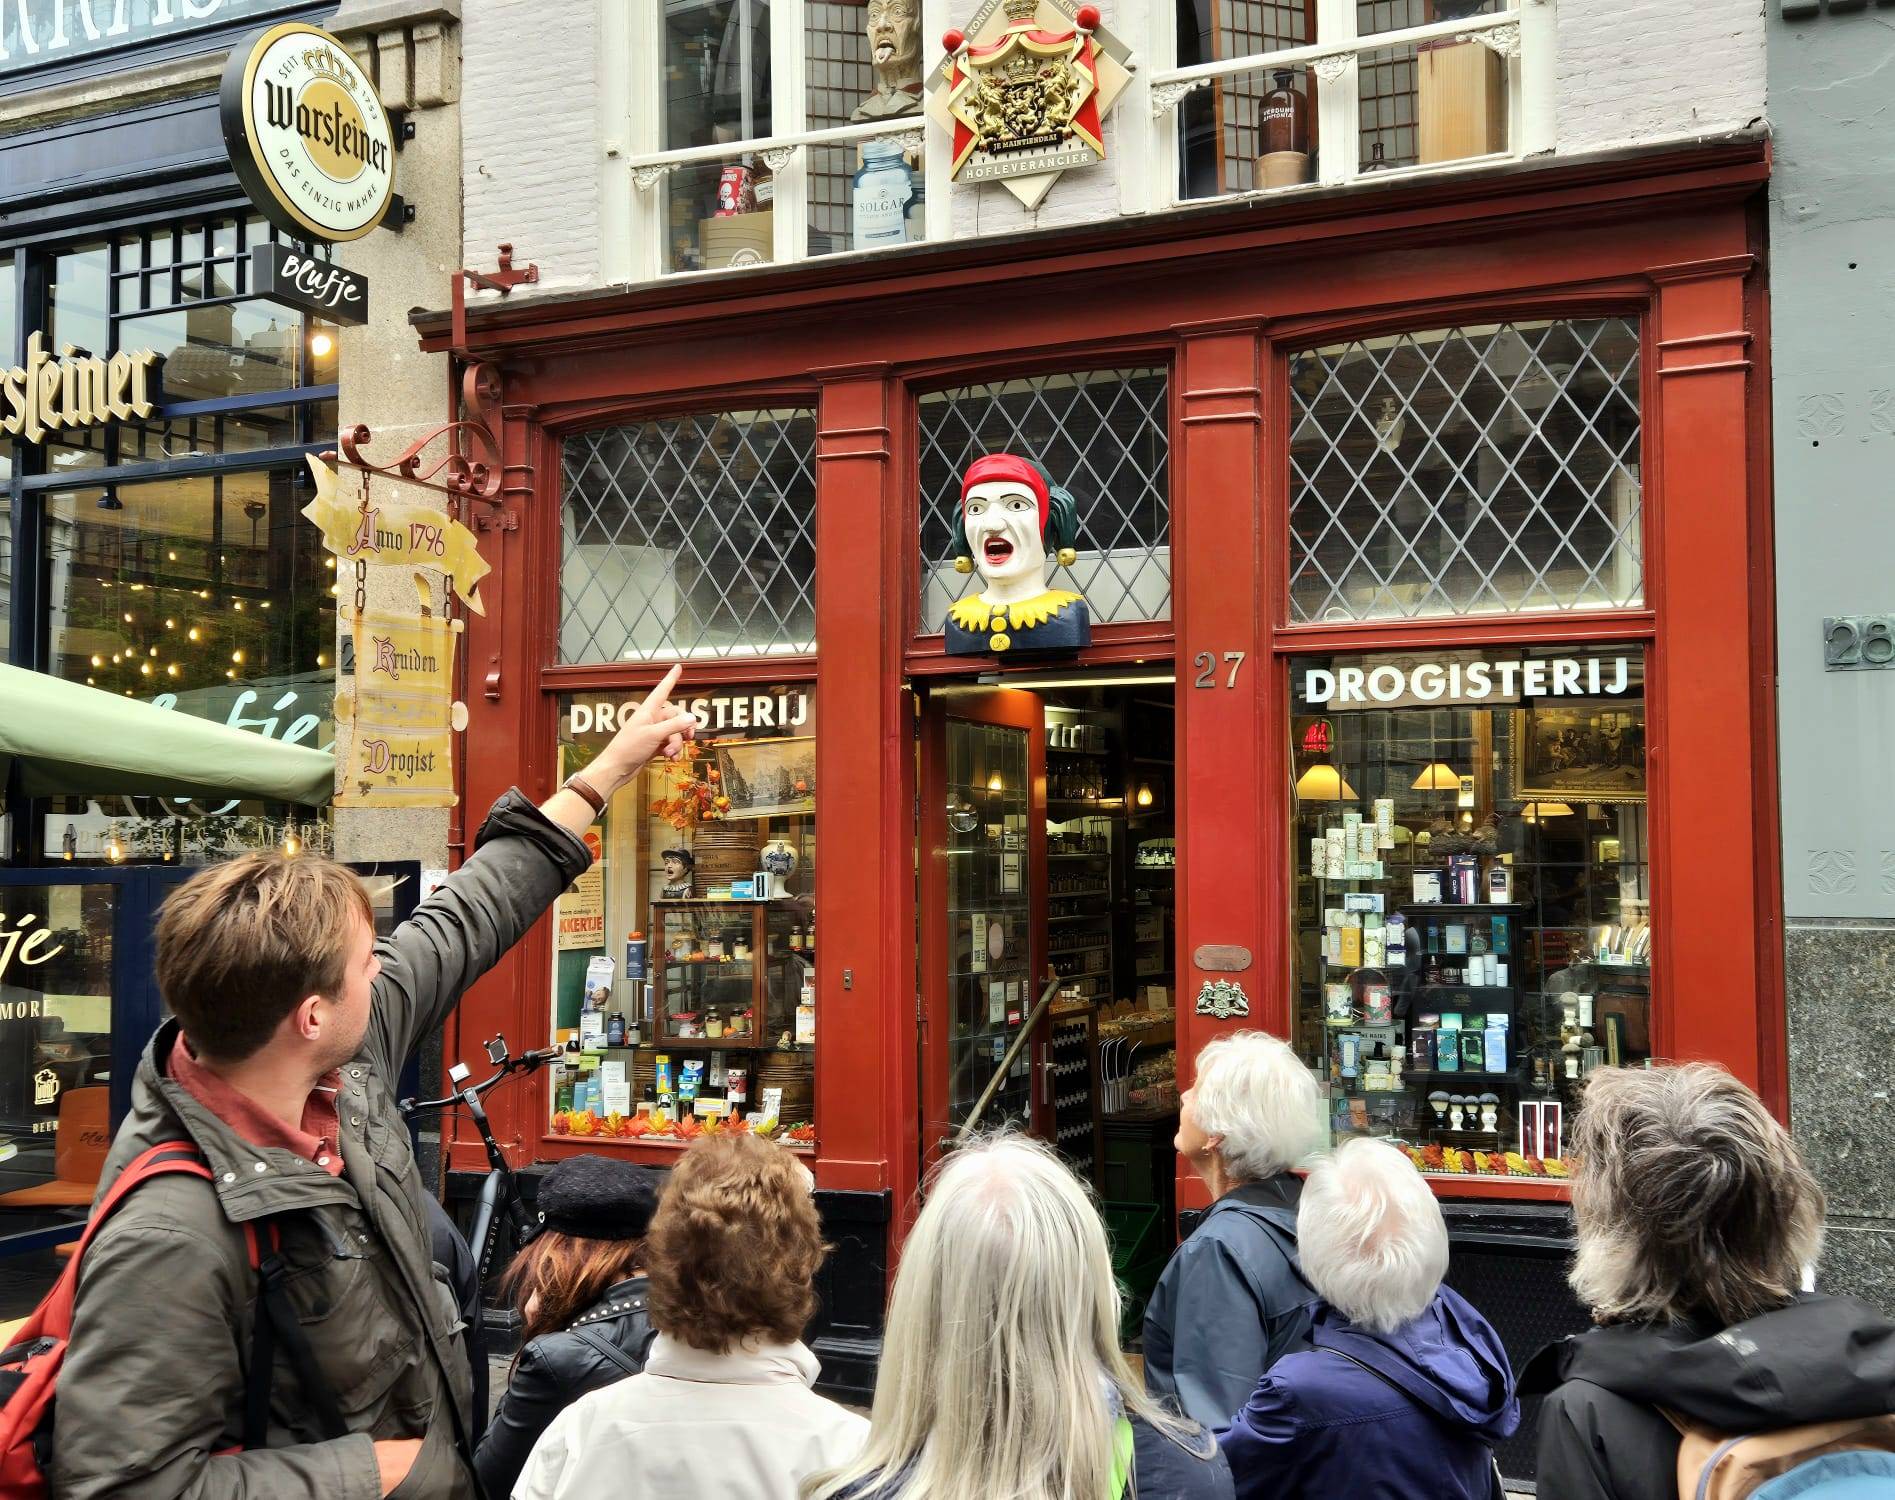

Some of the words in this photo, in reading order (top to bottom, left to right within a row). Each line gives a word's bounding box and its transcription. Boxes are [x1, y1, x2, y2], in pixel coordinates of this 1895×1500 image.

[278, 55, 300, 79] SEIT
[361, 90, 378, 121] 1753
[264, 78, 388, 175] Warsteiner
[279, 148, 301, 179] DAS
[300, 180, 343, 213] EINZIG
[346, 183, 378, 213] WAHRE
[966, 153, 1089, 179] HOFLEVERANCIER
[281, 255, 362, 307] Blufje
[346, 506, 403, 556] Anno
[408, 522, 445, 557] 1796
[372, 636, 440, 681] Kruiden
[1826, 620, 1895, 665] 28
[1194, 651, 1246, 689] 27
[1305, 656, 1628, 704] DROGISTERIJ
[362, 739, 436, 780] Drogist
[32, 1120, 60, 1134] BEER
